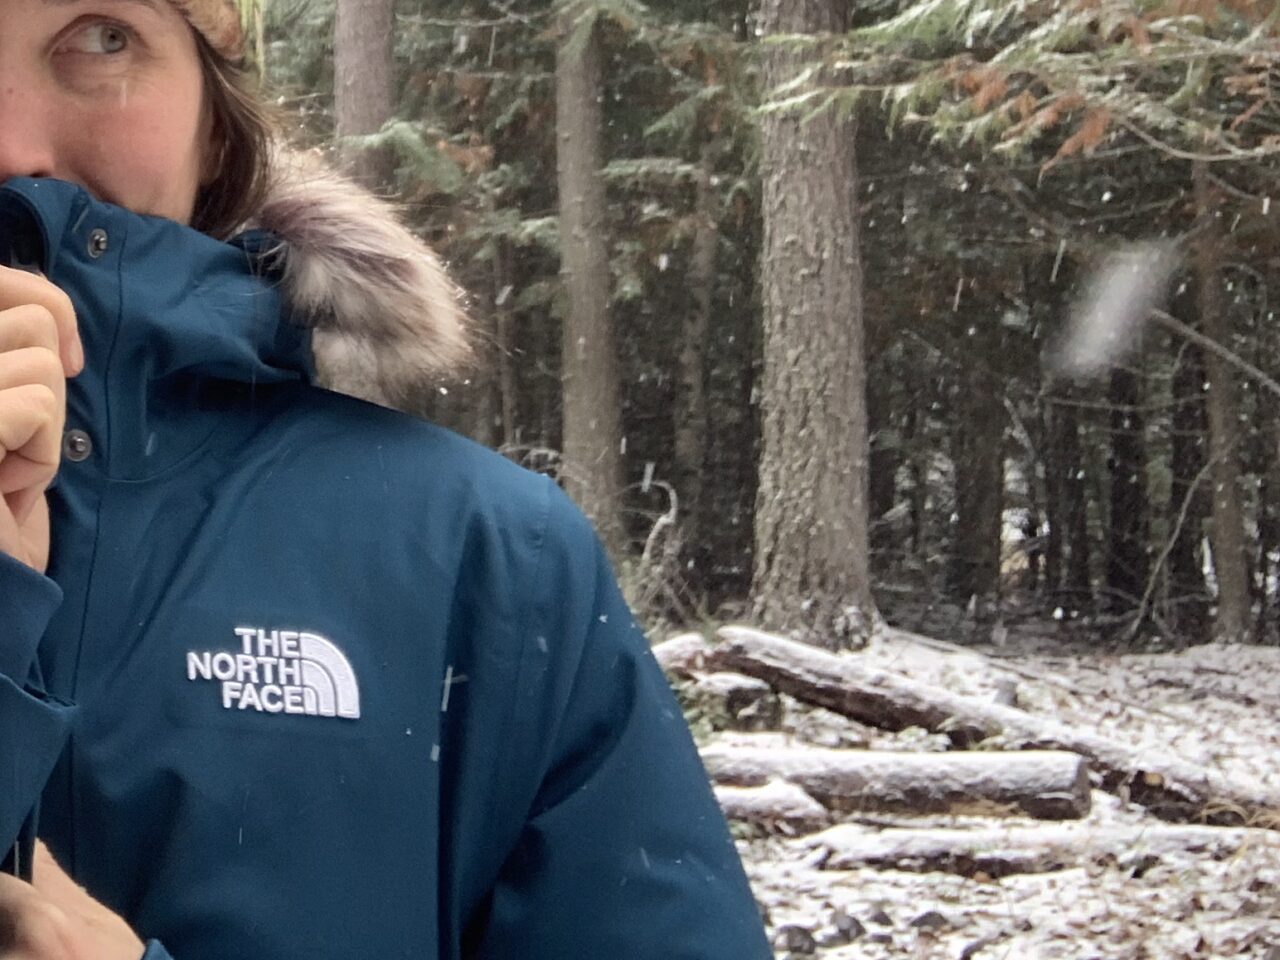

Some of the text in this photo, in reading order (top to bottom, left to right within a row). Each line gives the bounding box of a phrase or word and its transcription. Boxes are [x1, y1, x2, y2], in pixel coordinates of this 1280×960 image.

[234, 627, 300, 658] THE
[187, 652, 301, 685] NORTH
[222, 681, 304, 714] FACE
